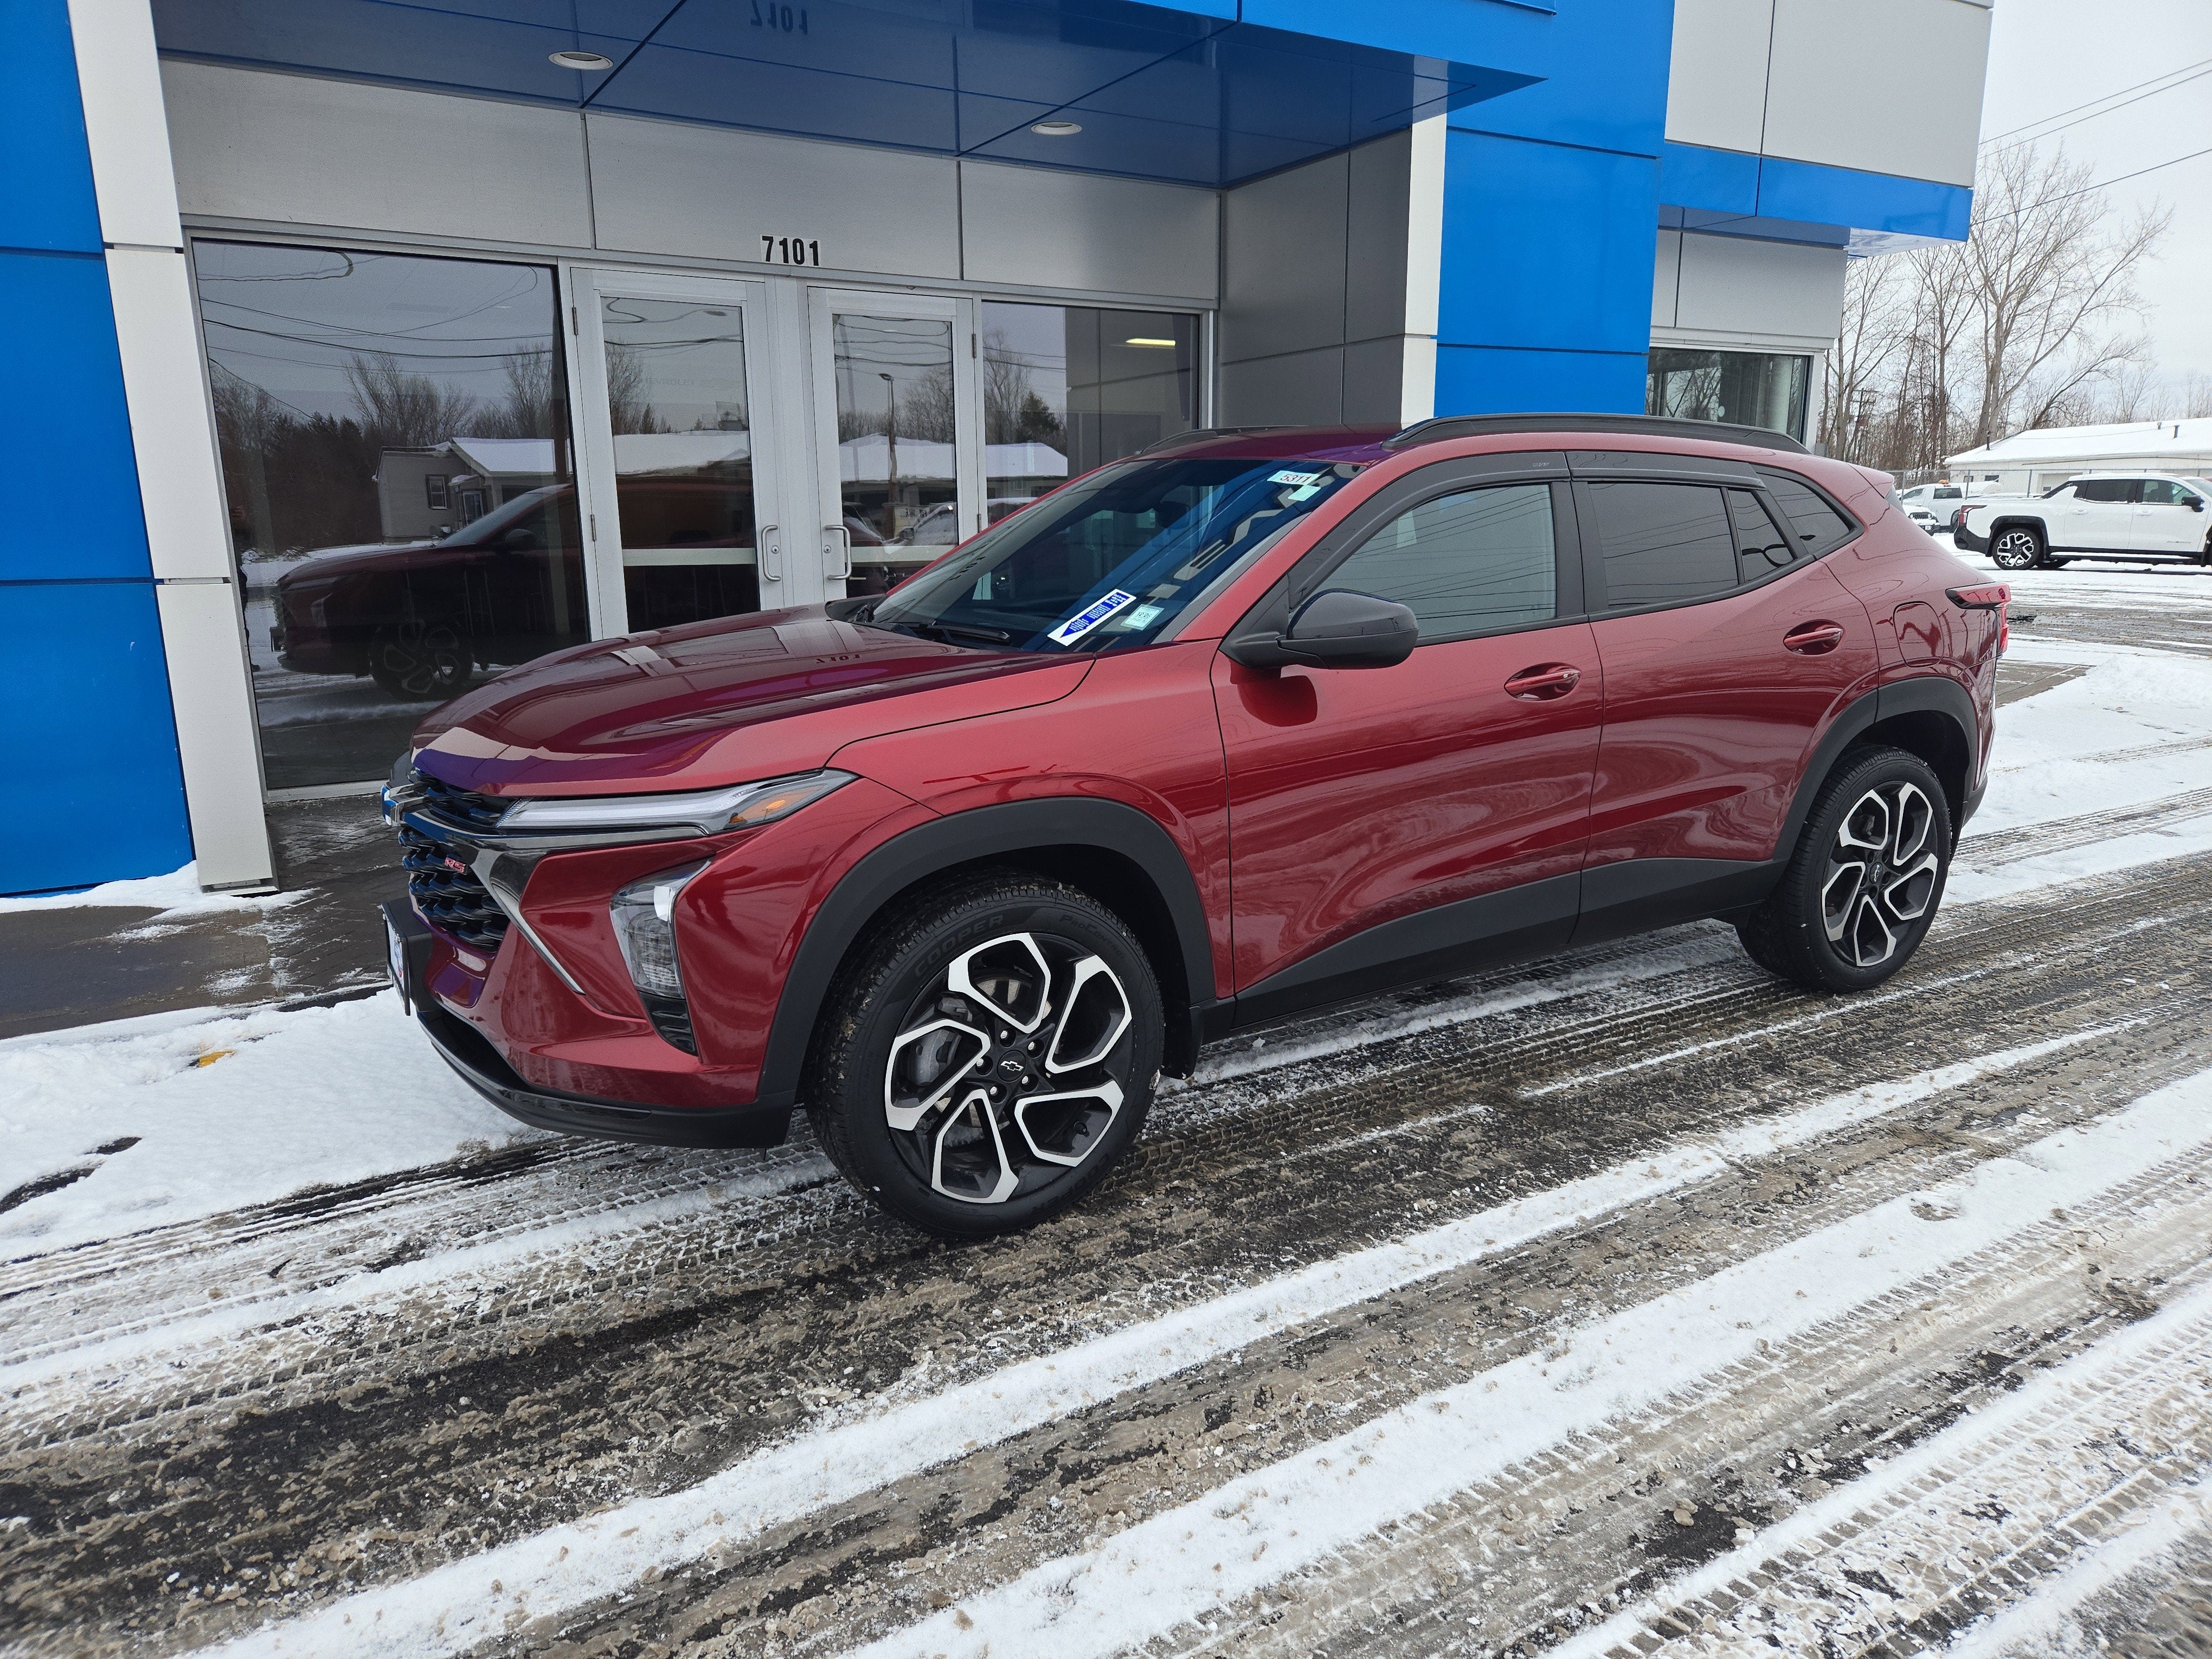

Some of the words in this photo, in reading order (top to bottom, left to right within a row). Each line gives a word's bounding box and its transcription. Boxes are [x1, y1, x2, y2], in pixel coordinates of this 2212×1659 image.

[762, 235, 820, 266] 7101
[1280, 474, 1312, 483] 5311
[445, 857, 466, 872] RS
[914, 915, 1004, 978] COOPER
